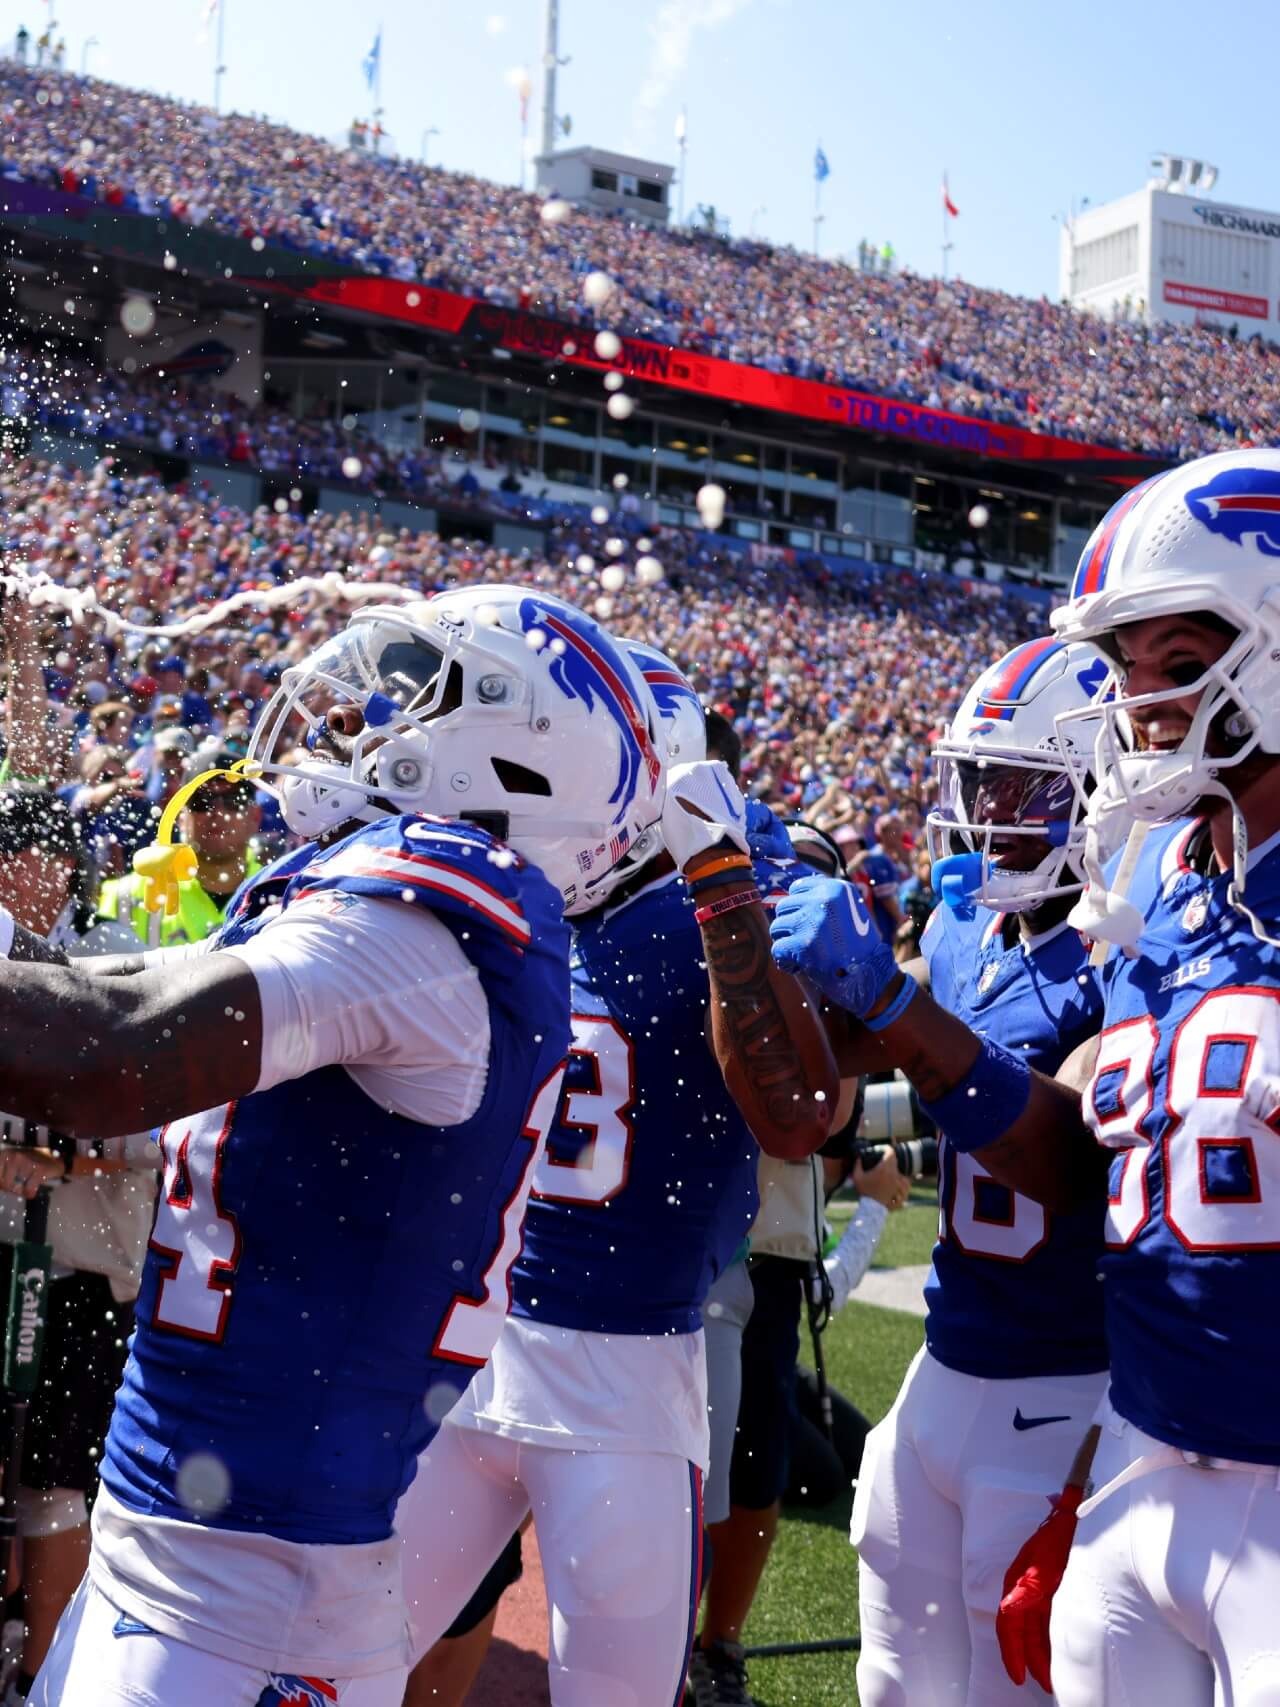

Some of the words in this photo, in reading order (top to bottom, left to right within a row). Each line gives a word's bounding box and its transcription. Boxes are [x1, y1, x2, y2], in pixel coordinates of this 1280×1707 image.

[848, 397, 989, 454] TOUCHDOWN
[1158, 957, 1211, 994] BILLS
[16, 1267, 45, 1363] Canon
